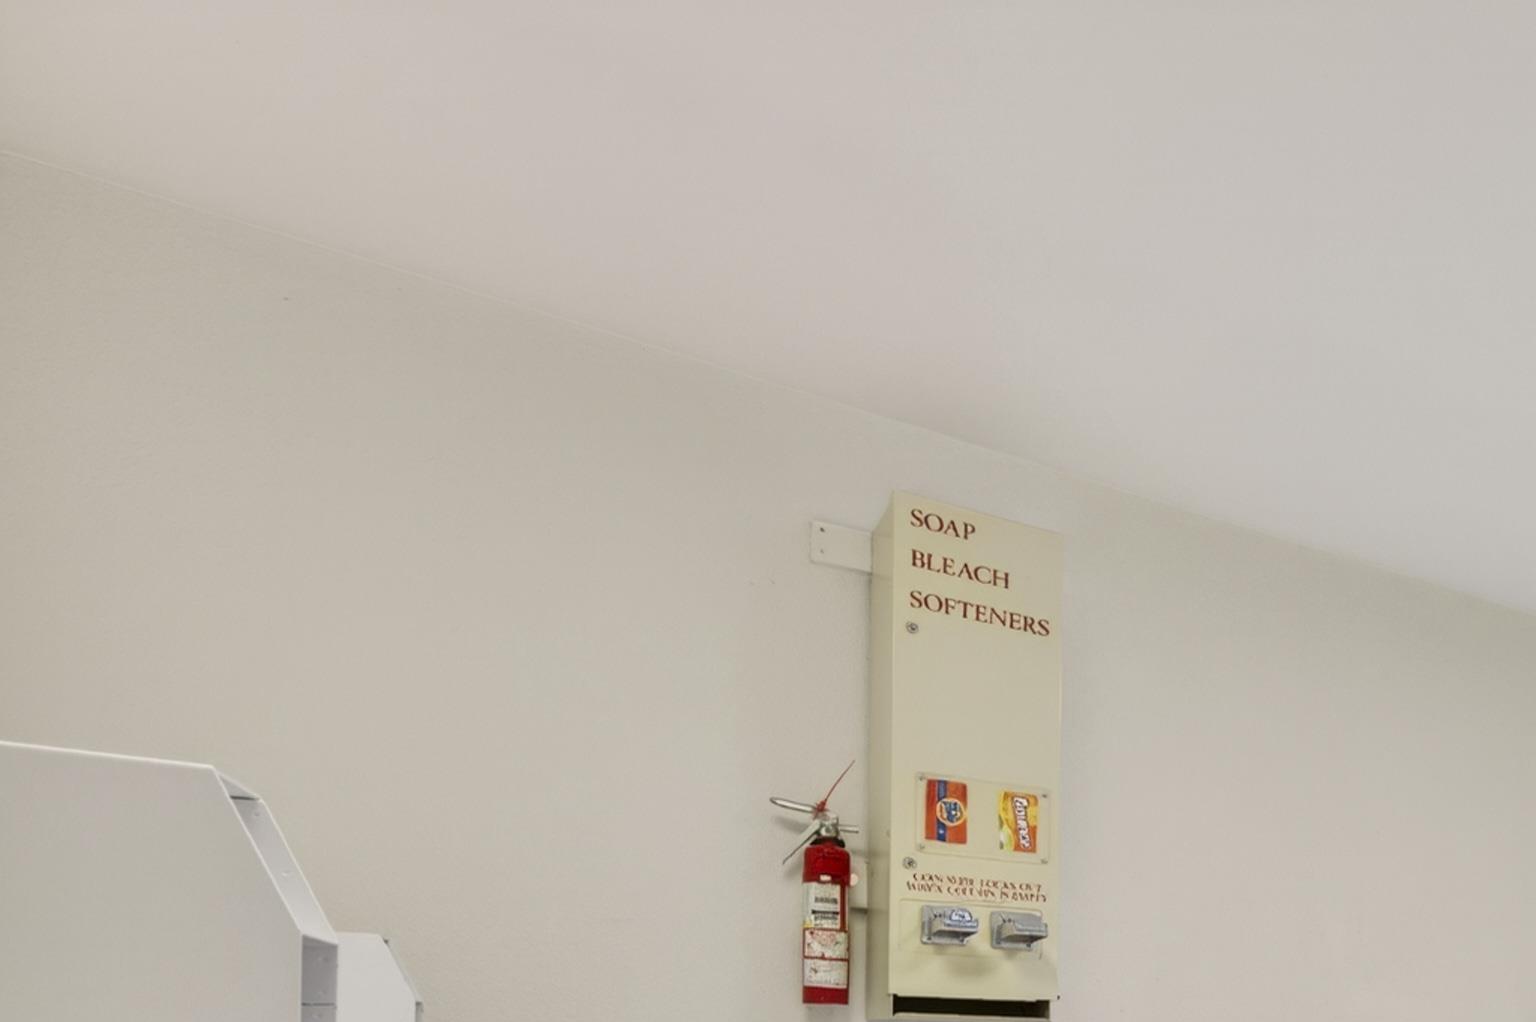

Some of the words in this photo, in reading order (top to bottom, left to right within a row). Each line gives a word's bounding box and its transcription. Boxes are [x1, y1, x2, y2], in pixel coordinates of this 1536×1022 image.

[910, 508, 976, 540] SOAP
[910, 549, 1010, 589] BLEACH
[909, 590, 1051, 637] SOFTENERS
